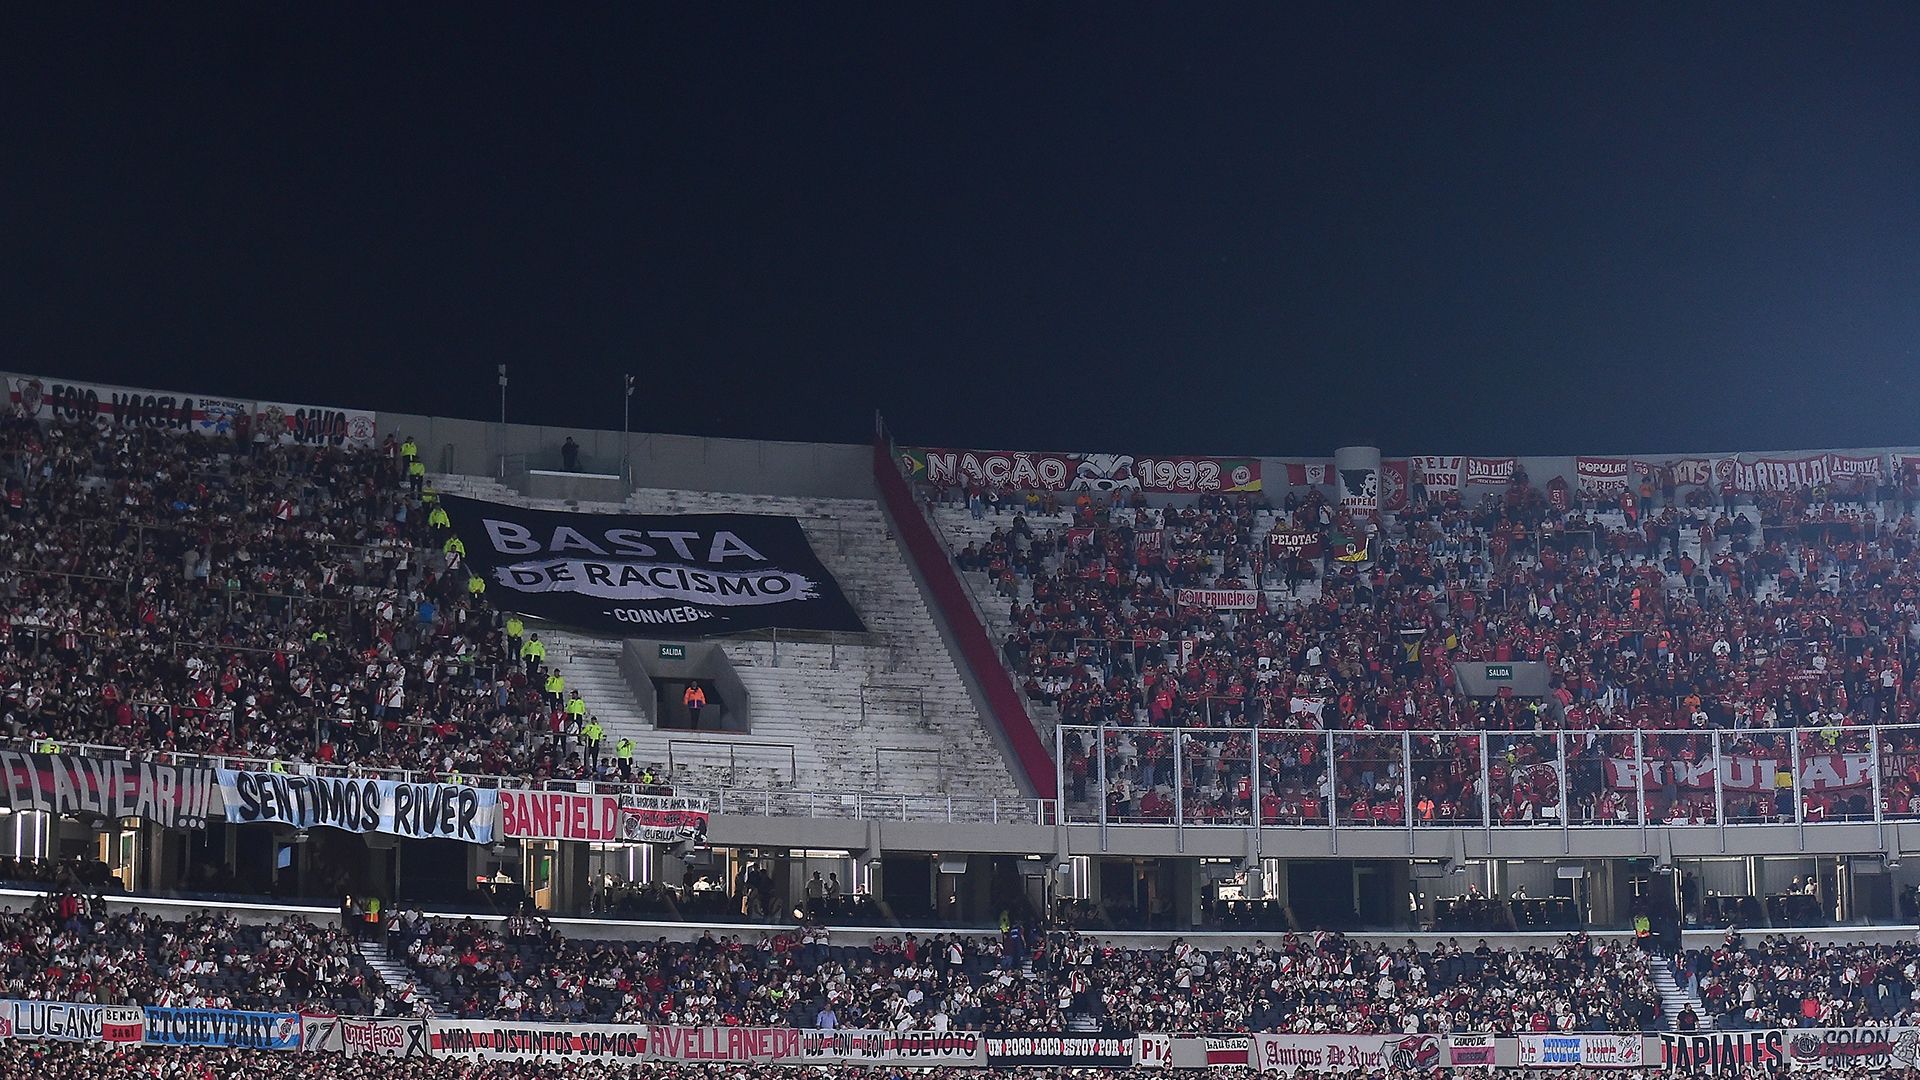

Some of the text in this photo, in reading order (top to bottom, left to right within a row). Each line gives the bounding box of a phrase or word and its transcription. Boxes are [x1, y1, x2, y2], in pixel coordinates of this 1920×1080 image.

[112, 393, 193, 431] VARELA
[294, 408, 346, 446] SAVIO
[926, 452, 1221, 492] NAÇÃO 1992
[1578, 462, 1627, 474] POPULAR
[1735, 455, 1832, 492] GARIBALDI
[1843, 457, 1879, 473] CURVA
[482, 518, 768, 564] BASTA
[1271, 533, 1319, 545] PELOTAS
[510, 562, 793, 598] DE RACISMO
[661, 647, 682, 656] SALIDA
[1489, 669, 1510, 677] SALIDA
[2, 751, 52, 812] EL
[236, 771, 478, 841] SENTIMOS RIVER
[503, 791, 617, 842] BANFIELD
[106, 1009, 140, 1021] BENJA
[148, 1006, 275, 1047] ETCHEVERRY
[439, 1028, 476, 1054] MIRA
[494, 1029, 574, 1056] DISTINTOS
[580, 1032, 638, 1057] SOMOS
[651, 1026, 800, 1060] AVELLANEDA
[805, 1032, 825, 1056] LUZ
[861, 1032, 885, 1057] LEON
[987, 1038, 1003, 1057] UN
[1004, 1038, 1032, 1057] POCO
[1033, 1038, 1061, 1057] LOCO
[1062, 1038, 1097, 1057] ESTOY
[1098, 1038, 1120, 1057] POR
[1205, 1039, 1249, 1050] LAUTARO
[1453, 1036, 1487, 1046] CAMPO DE
[1519, 1038, 1617, 1063] LA NUEVA LUNA
[1823, 1029, 1890, 1049] COLON
[1265, 1041, 1384, 1067] Amigos De River
[1661, 1030, 1786, 1076] TAPIALES
